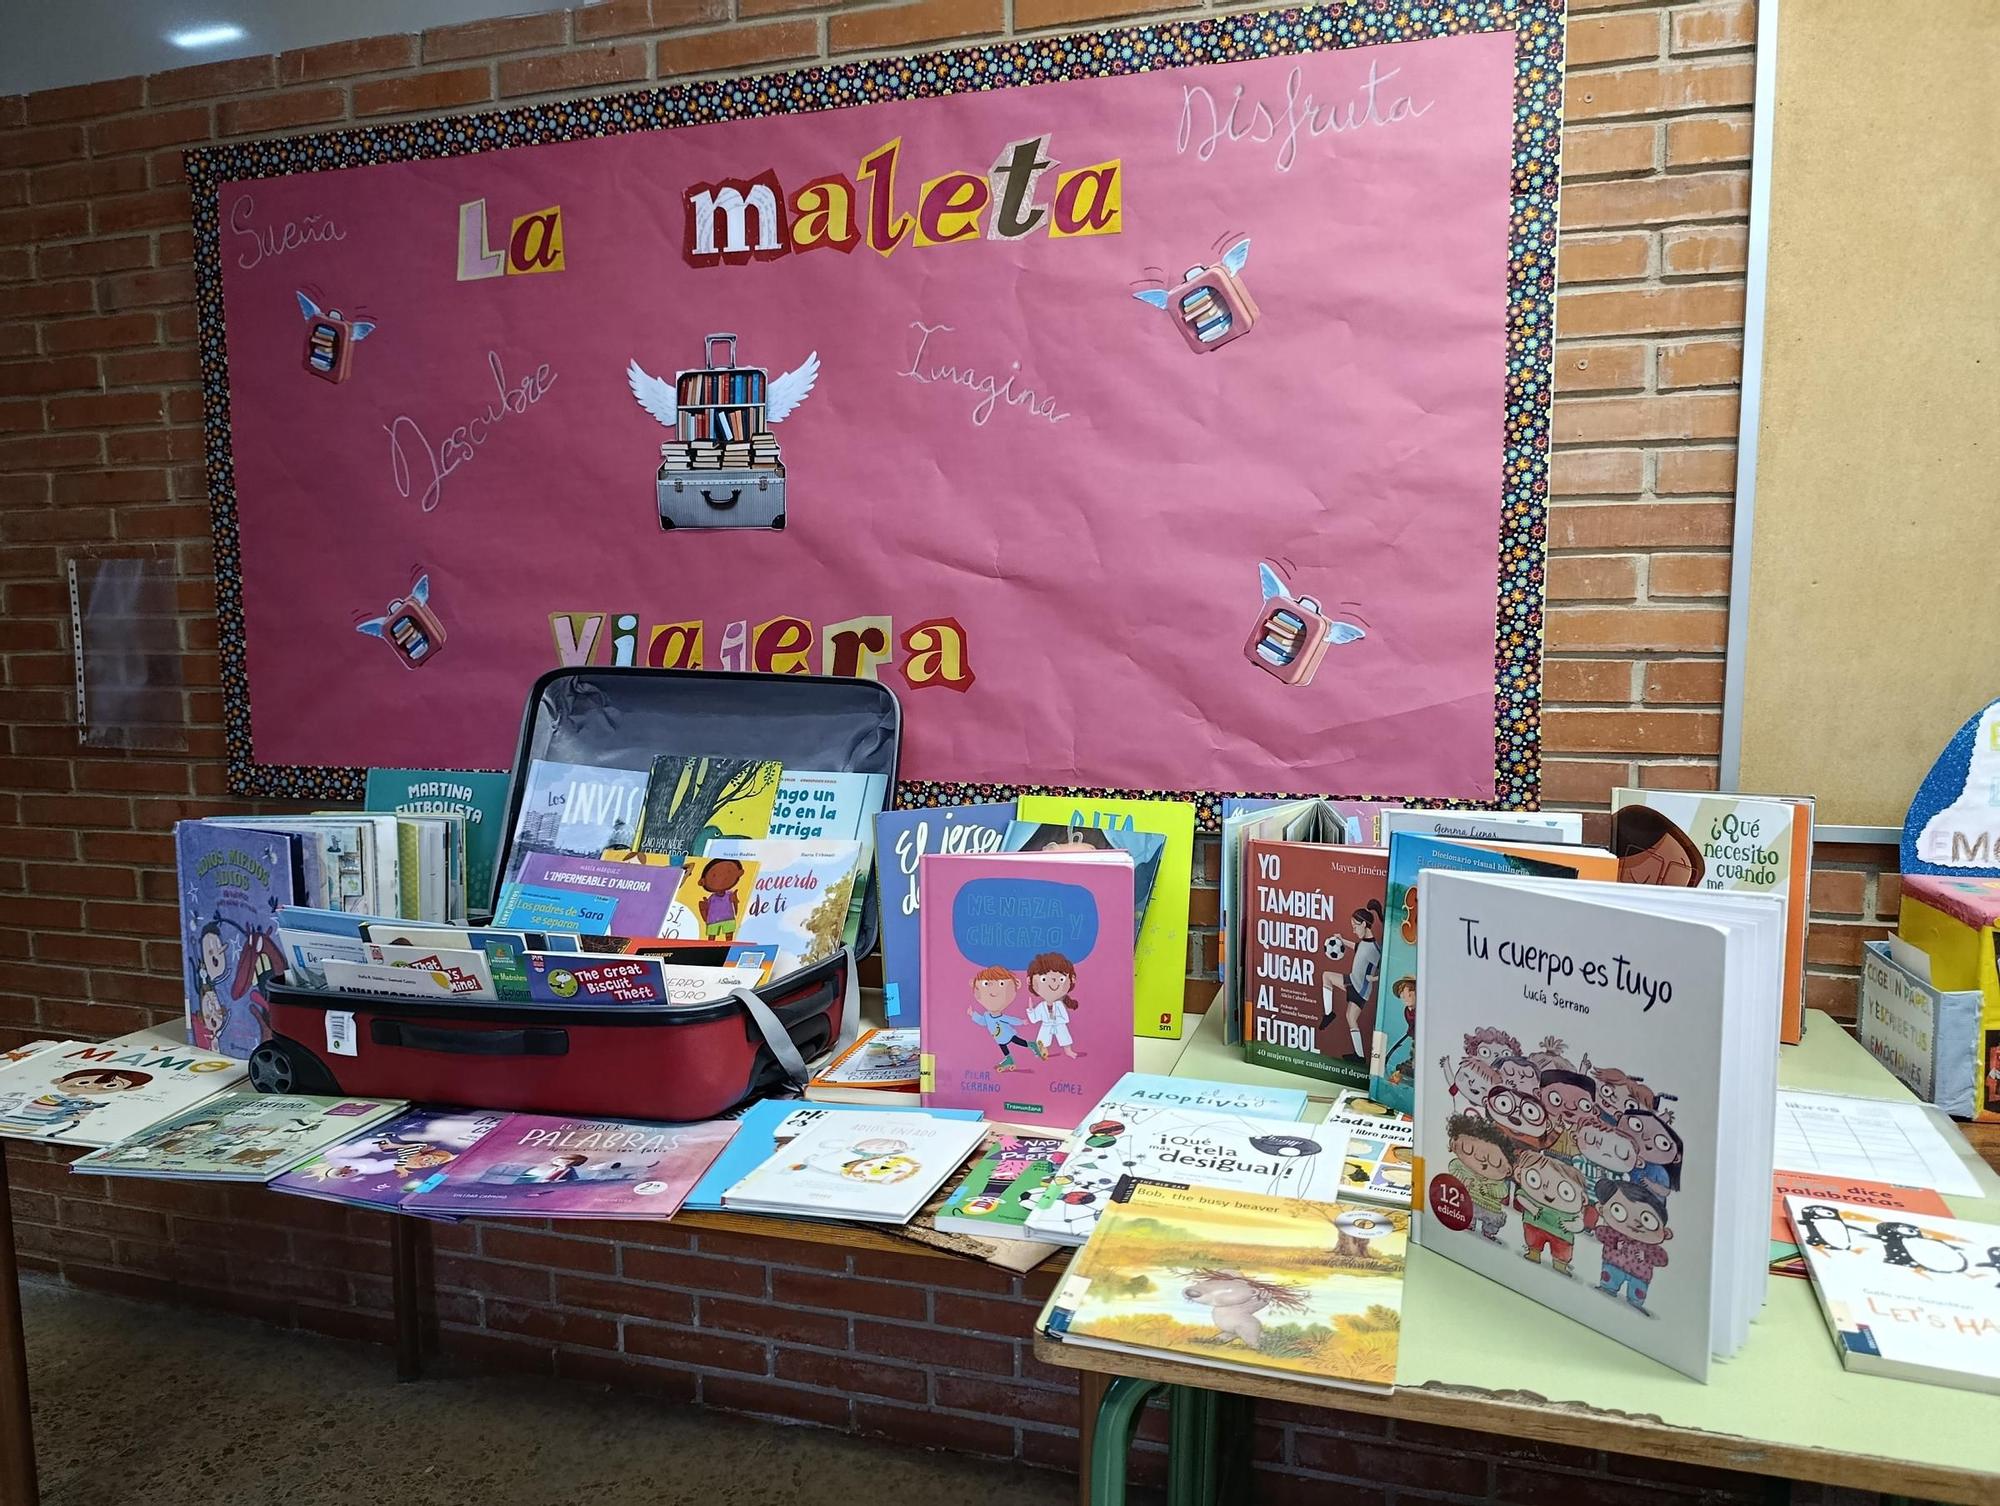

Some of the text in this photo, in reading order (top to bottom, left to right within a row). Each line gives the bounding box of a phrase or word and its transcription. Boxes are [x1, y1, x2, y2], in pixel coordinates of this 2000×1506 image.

[1176, 60, 1435, 173] Disfruta
[460, 137, 1117, 278] La maleta
[231, 194, 346, 269] Sueña
[898, 321, 1070, 426] Imagina
[384, 351, 558, 512] Descubre
[408, 782, 473, 802] MARTINA
[548, 791, 566, 807] Los
[777, 789, 835, 804] ngo un
[773, 803, 837, 820] do en la
[770, 821, 822, 840] arriga
[1711, 814, 1760, 843] ¿Qué
[895, 822, 929, 874] El
[1704, 843, 1779, 865] necesito
[1257, 853, 1281, 881] YO
[1432, 849, 1472, 865] Diccionario
[1473, 858, 1496, 870] visual
[544, 871, 651, 892] L'IMPERMEABLE D'AURORA
[756, 869, 818, 891] acuerdo
[1357, 865, 1387, 877] Jiméne
[1716, 864, 1776, 885] cuando
[1707, 879, 1724, 890] me
[534, 902, 564, 916] padres
[566, 906, 577, 917] de
[578, 907, 604, 921] Sara
[749, 893, 787, 917] de ti
[1257, 886, 1334, 922] TAMBIÉN
[531, 916, 579, 929] se separan
[1257, 918, 1319, 953] QUIERO
[1459, 917, 1489, 960] Tu
[1498, 941, 1574, 986] cuerpo
[1579, 961, 1609, 988] es
[575, 963, 643, 982] The Great
[1257, 952, 1315, 986] JUGAR
[587, 977, 632, 994] Biscuit
[614, 986, 654, 1000] Theft
[668, 979, 705, 988] ERPO
[1257, 984, 1279, 1013] AL
[1523, 984, 1590, 1014] Lucía Serrano
[1256, 1013, 1320, 1055] FÚTBOL
[965, 1070, 990, 1080] PILAR
[1267, 1051, 1292, 1063] mujeres
[1293, 1057, 1304, 1066] que
[1306, 1058, 1340, 1073] cambiaron
[1341, 1066, 1348, 1075] el
[1349, 1069, 1370, 1080] depor
[961, 1081, 1001, 1093] SERRANO
[1380, 1123, 1412, 1133] uno
[518, 1128, 688, 1151] PALABRAS
[1194, 1145, 1237, 1157] tela
[1159, 1149, 1293, 1179] desigual!
[1137, 1187, 1165, 1200] Bob,
[1172, 1193, 1194, 1202] the
[1199, 1196, 1229, 1208] busy
[1234, 1201, 1280, 1213] beaver
[1776, 1185, 1905, 1208] palabrotas
[1848, 1187, 1893, 1199] dice
[1437, 1204, 1466, 1222] edición
[1953, 1316, 2000, 1337] HA
